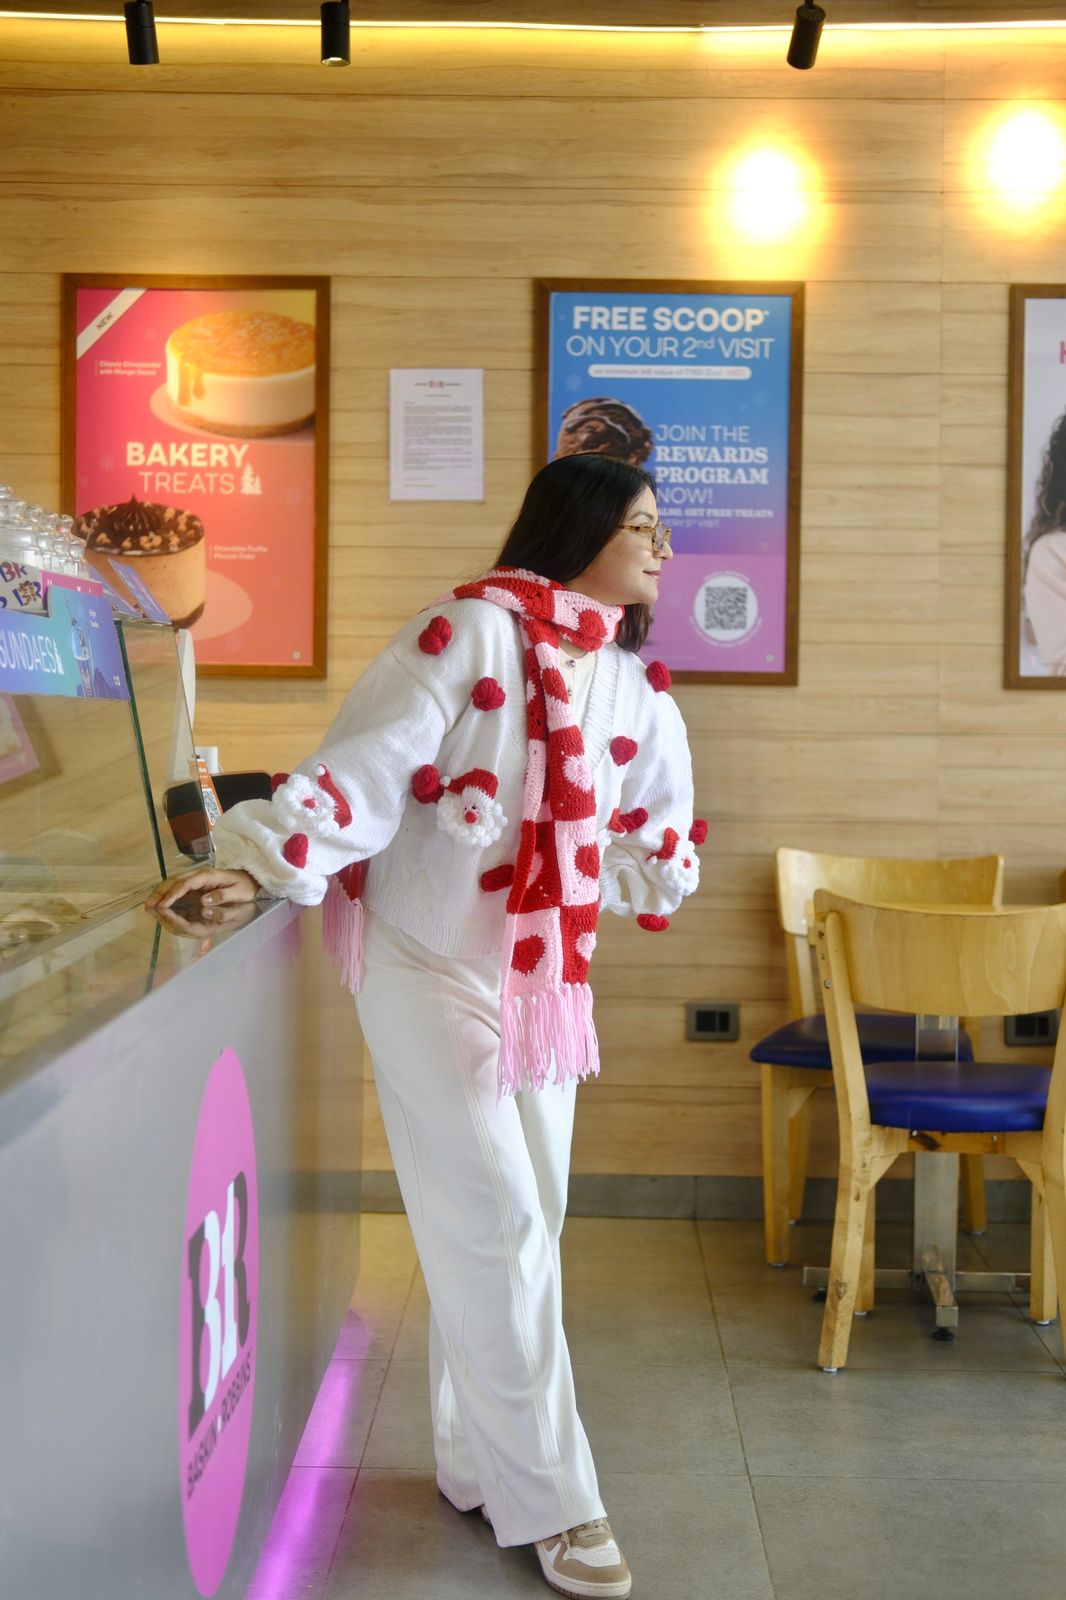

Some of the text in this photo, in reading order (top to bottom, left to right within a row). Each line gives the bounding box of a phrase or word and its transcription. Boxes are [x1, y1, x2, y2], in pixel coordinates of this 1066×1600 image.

[573, 306, 648, 330] FREE
[566, 335, 775, 360] ON YOUR 2nd VISIT
[656, 424, 750, 443] JOIN THE
[126, 442, 249, 468] BAKERY
[655, 445, 769, 464] REWARDS
[139, 471, 236, 495] TREATS
[655, 466, 770, 485] PROGRAM
[656, 487, 713, 504] NOW!
[735, 509, 774, 518] TREATS
[0, 628, 58, 674] SUNDAES
